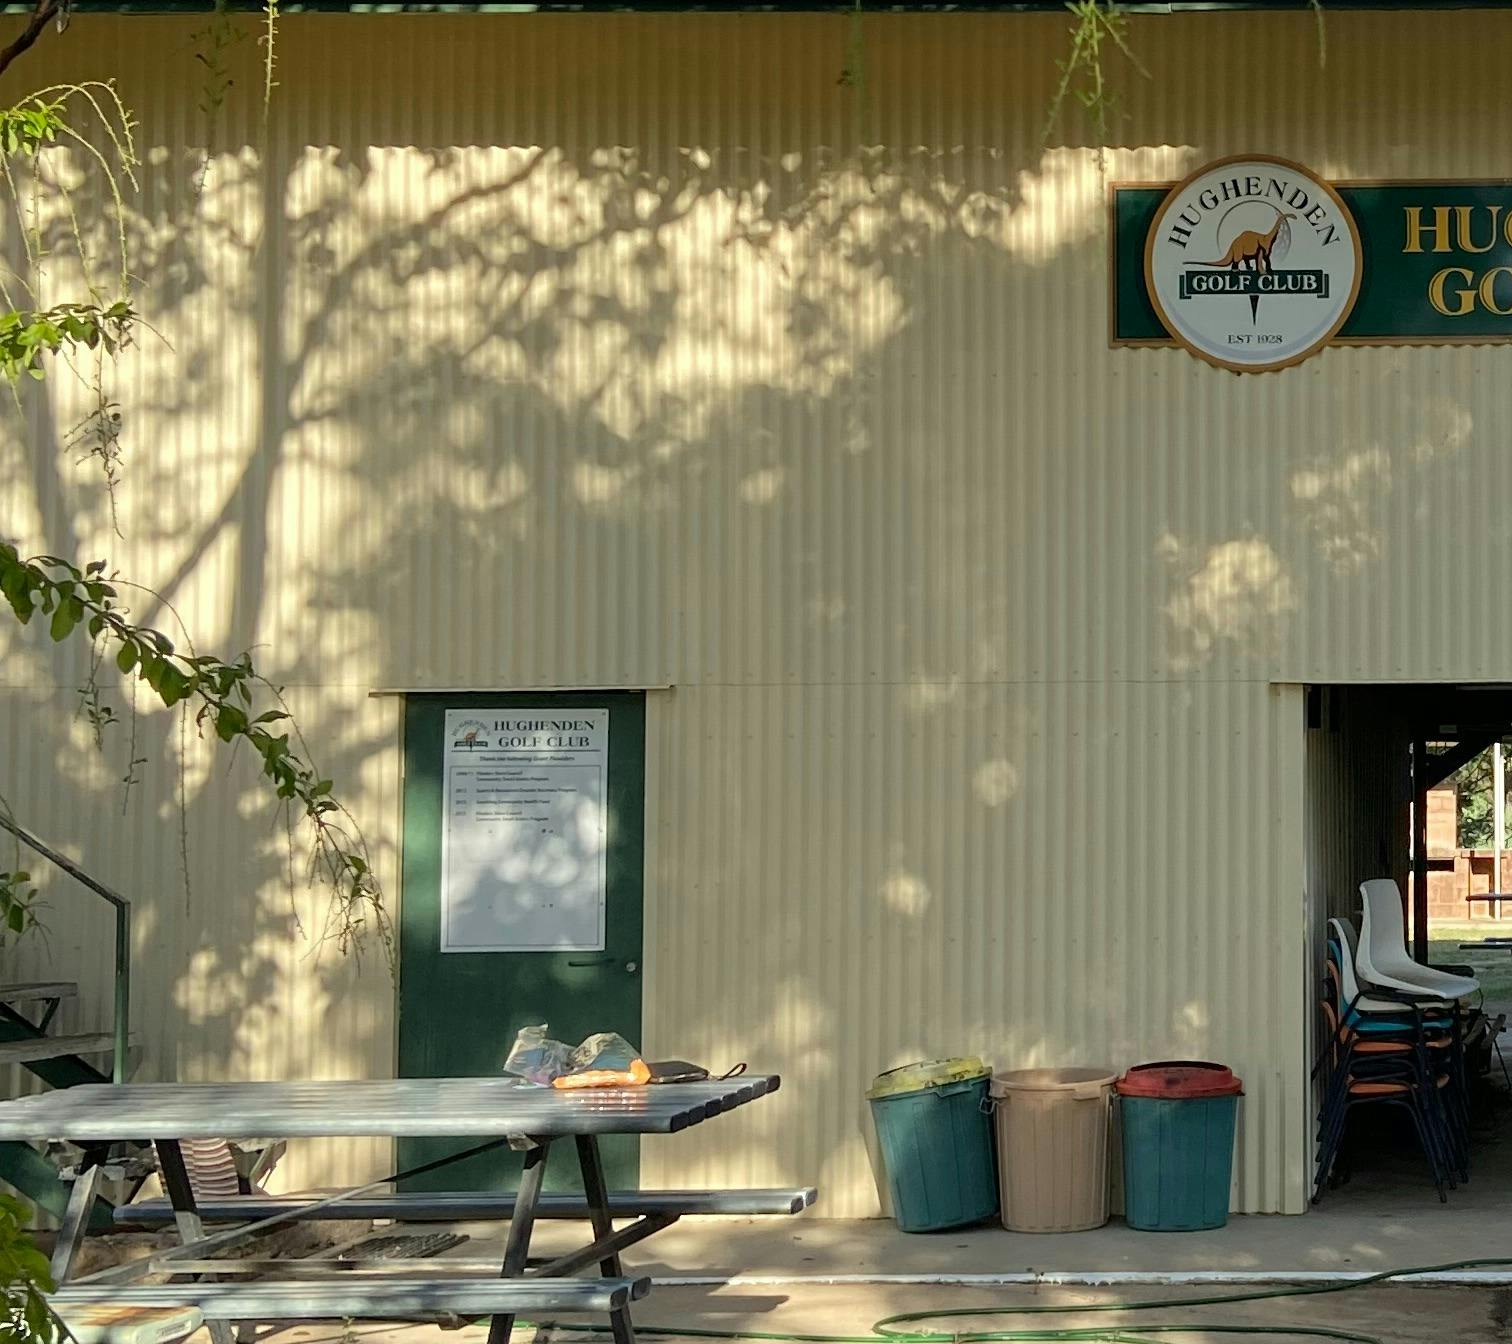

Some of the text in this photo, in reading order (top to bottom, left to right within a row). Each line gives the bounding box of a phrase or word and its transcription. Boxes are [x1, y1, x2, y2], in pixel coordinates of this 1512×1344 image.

[1167, 176, 1341, 249] HUGHENDEN
[1192, 274, 1318, 292] GOLF CLUB
[1228, 333, 1284, 345] EST 1928
[494, 720, 595, 731] HUGHENDEN
[498, 736, 541, 748] GOLF
[546, 736, 590, 748] CLUB
